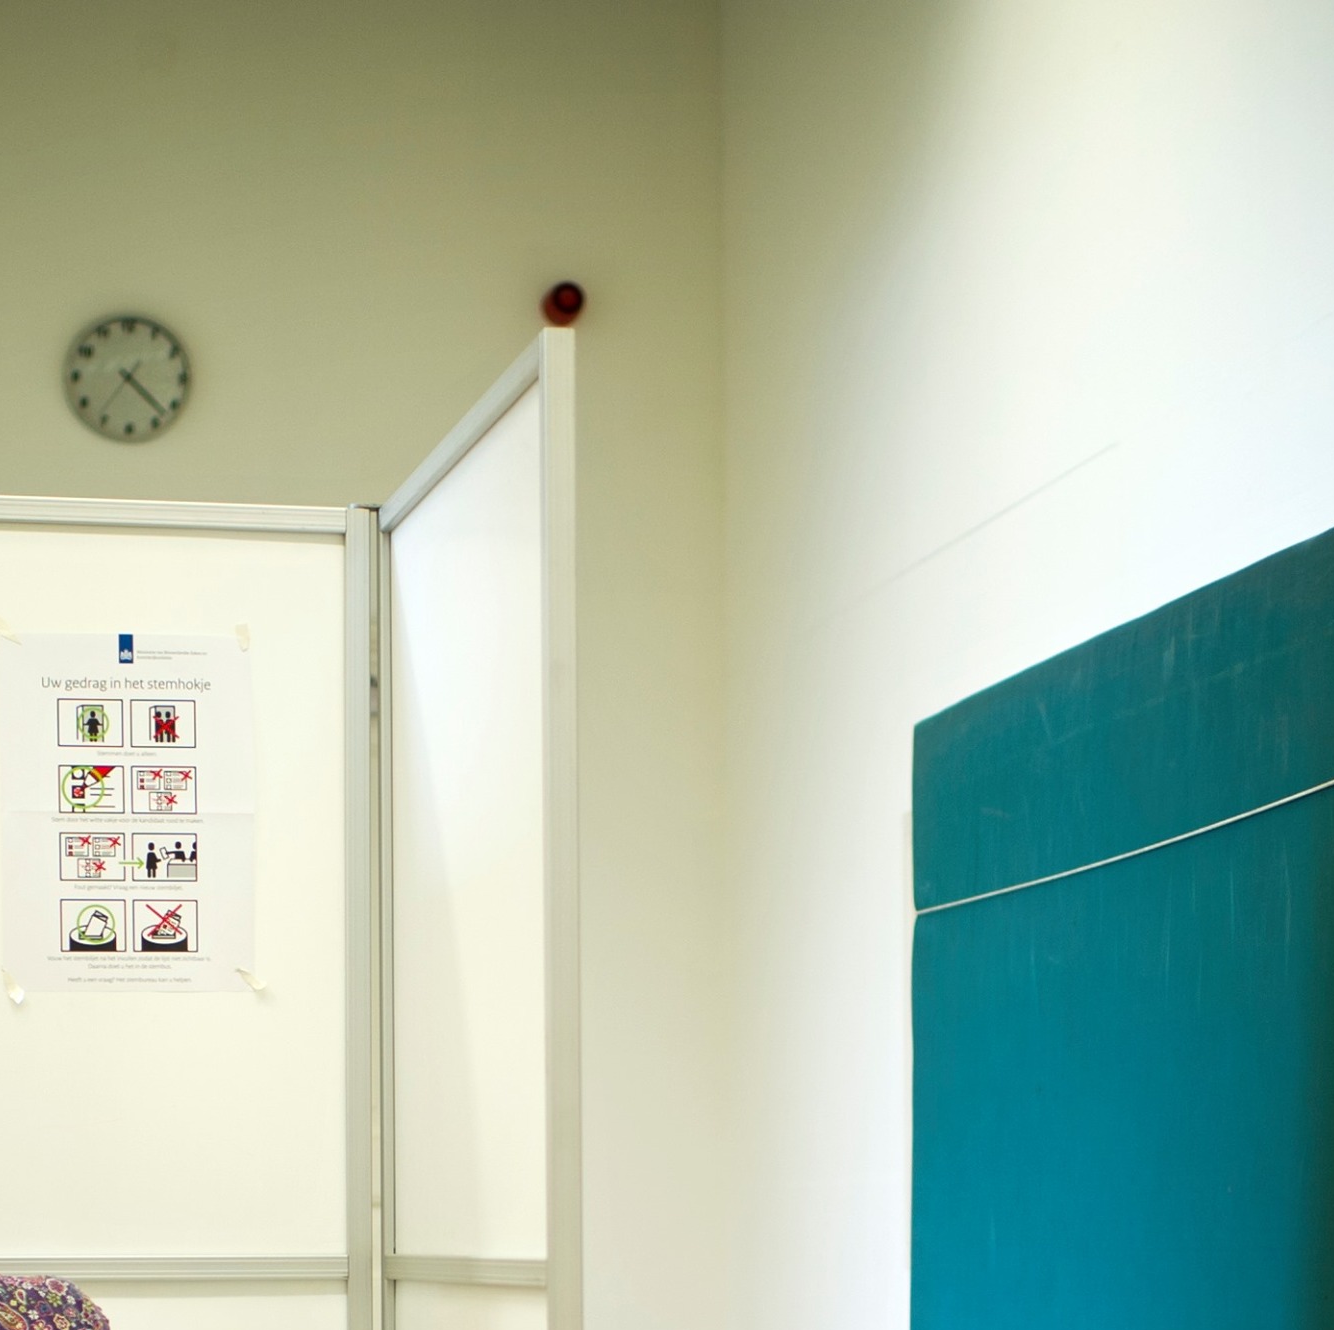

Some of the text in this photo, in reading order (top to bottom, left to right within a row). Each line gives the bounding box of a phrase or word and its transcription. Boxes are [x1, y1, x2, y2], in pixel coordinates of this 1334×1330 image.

[41, 676, 212, 693] Uw gedrag in het stemhokje
